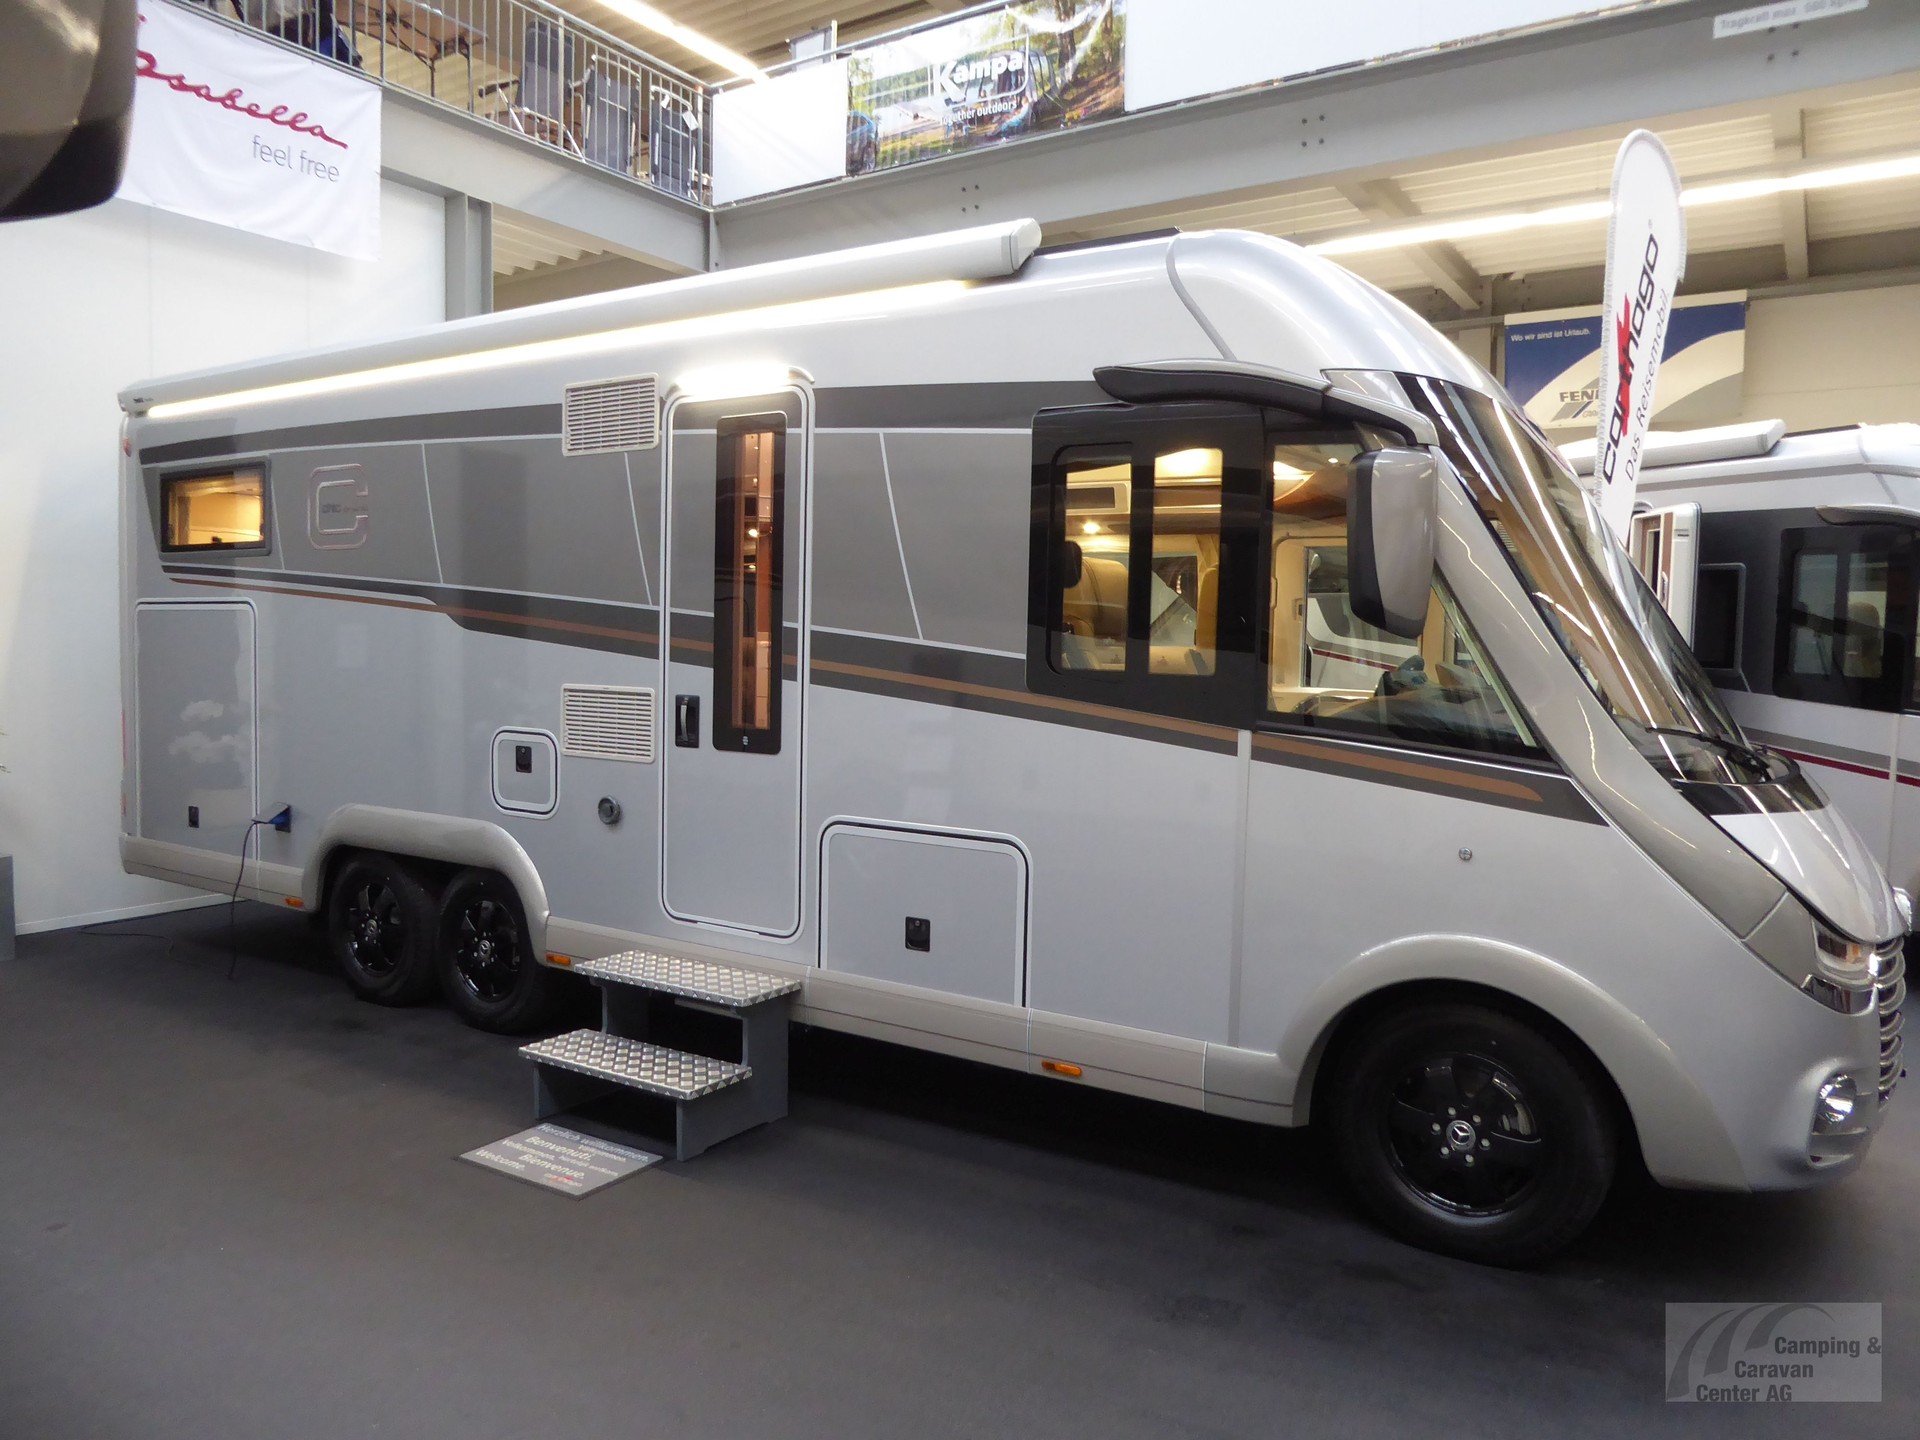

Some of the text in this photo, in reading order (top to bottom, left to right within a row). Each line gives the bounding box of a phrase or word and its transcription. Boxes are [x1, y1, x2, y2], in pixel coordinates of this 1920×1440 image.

[932, 50, 1024, 103] Kampa
[976, 101, 1018, 117] outdoors
[252, 134, 340, 183] feel free
[1511, 328, 1590, 342] Wo wir sind ist Urlaub.
[1602, 232, 1659, 486] carthago
[1560, 389, 1600, 402] FEN
[1625, 434, 1641, 482] Das
[537, 1123, 580, 1142] Herzlich
[475, 1150, 526, 1171] Welcome.
[525, 1136, 592, 1161] Benvenuti.
[518, 1152, 585, 1180] Bienvenue.
